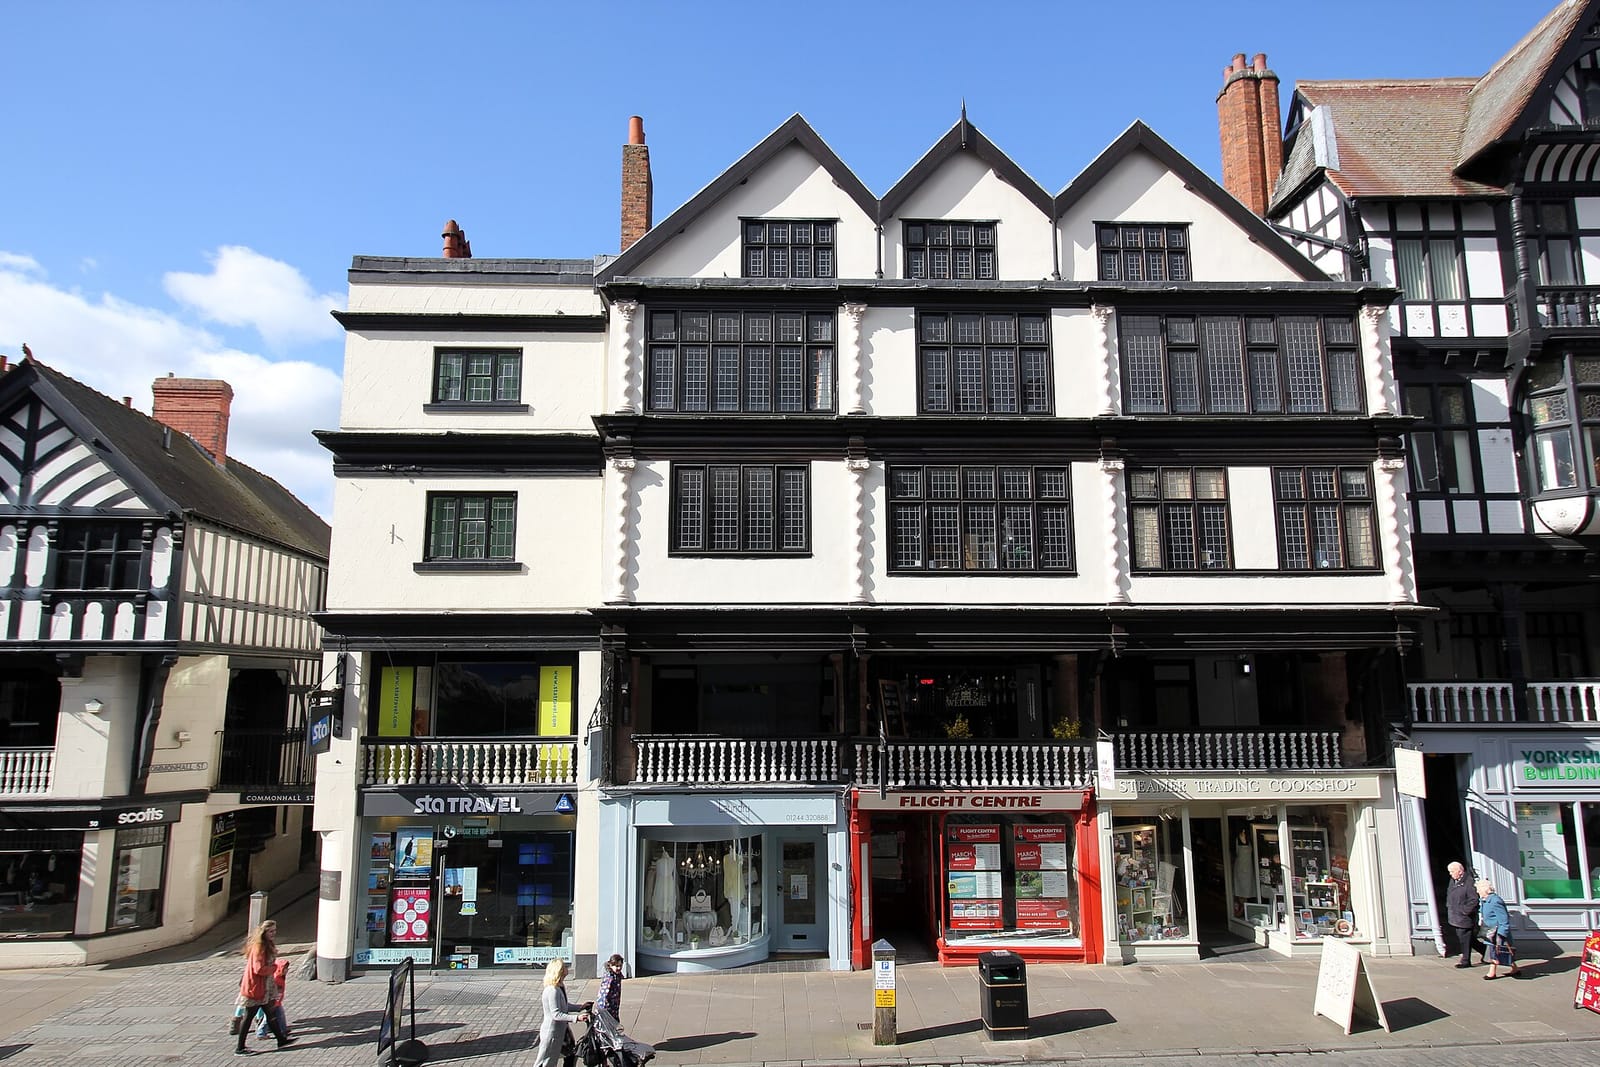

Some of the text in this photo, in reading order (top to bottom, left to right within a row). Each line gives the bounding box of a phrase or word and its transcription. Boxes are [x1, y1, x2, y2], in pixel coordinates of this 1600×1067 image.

[946, 695, 987, 706] WELCOME
[313, 721, 329, 740] sta
[1521, 750, 1600, 764] YORKSHI
[1119, 779, 1357, 793] STEAMER TRADING COOKSHOP
[414, 795, 521, 813] sta TRAVEL
[899, 796, 1042, 807] FLIGHT CENTRE
[117, 807, 164, 824] scotts
[1525, 830, 1531, 838] 1
[1528, 850, 1535, 859] 2
[1529, 866, 1536, 875] 3
[497, 951, 512, 961] sta
